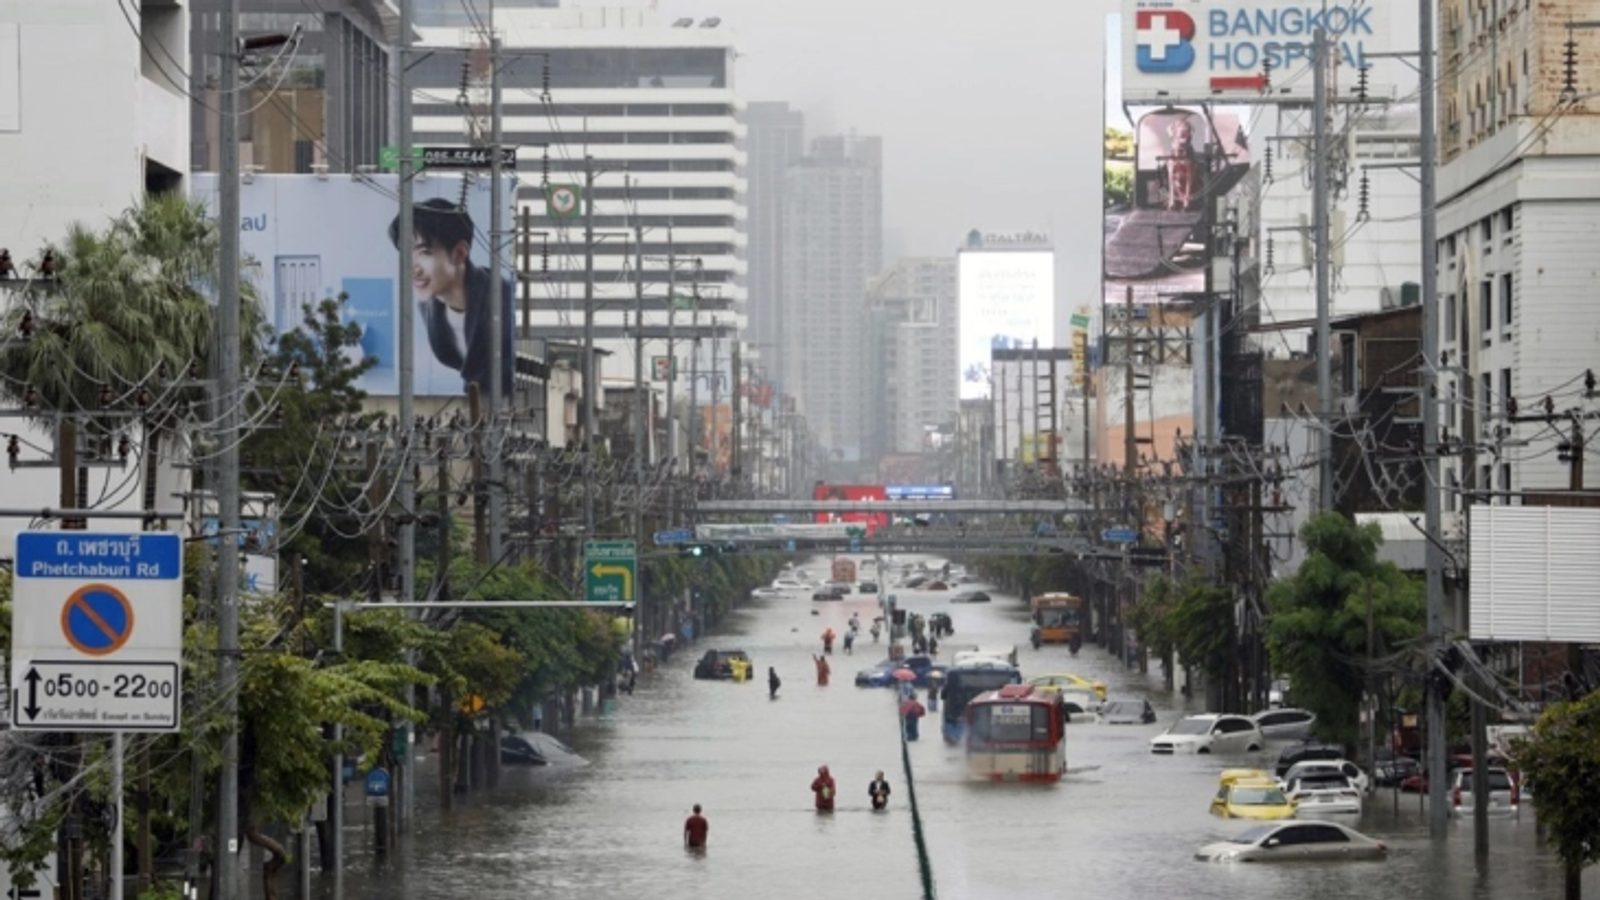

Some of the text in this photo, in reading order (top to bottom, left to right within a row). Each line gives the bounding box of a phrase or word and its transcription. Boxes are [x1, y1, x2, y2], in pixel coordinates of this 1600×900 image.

[1209, 7, 1373, 36] BANGKOK
[1209, 41, 1373, 70] HOSPAL
[32, 561, 160, 576] Phetchaburi Rd
